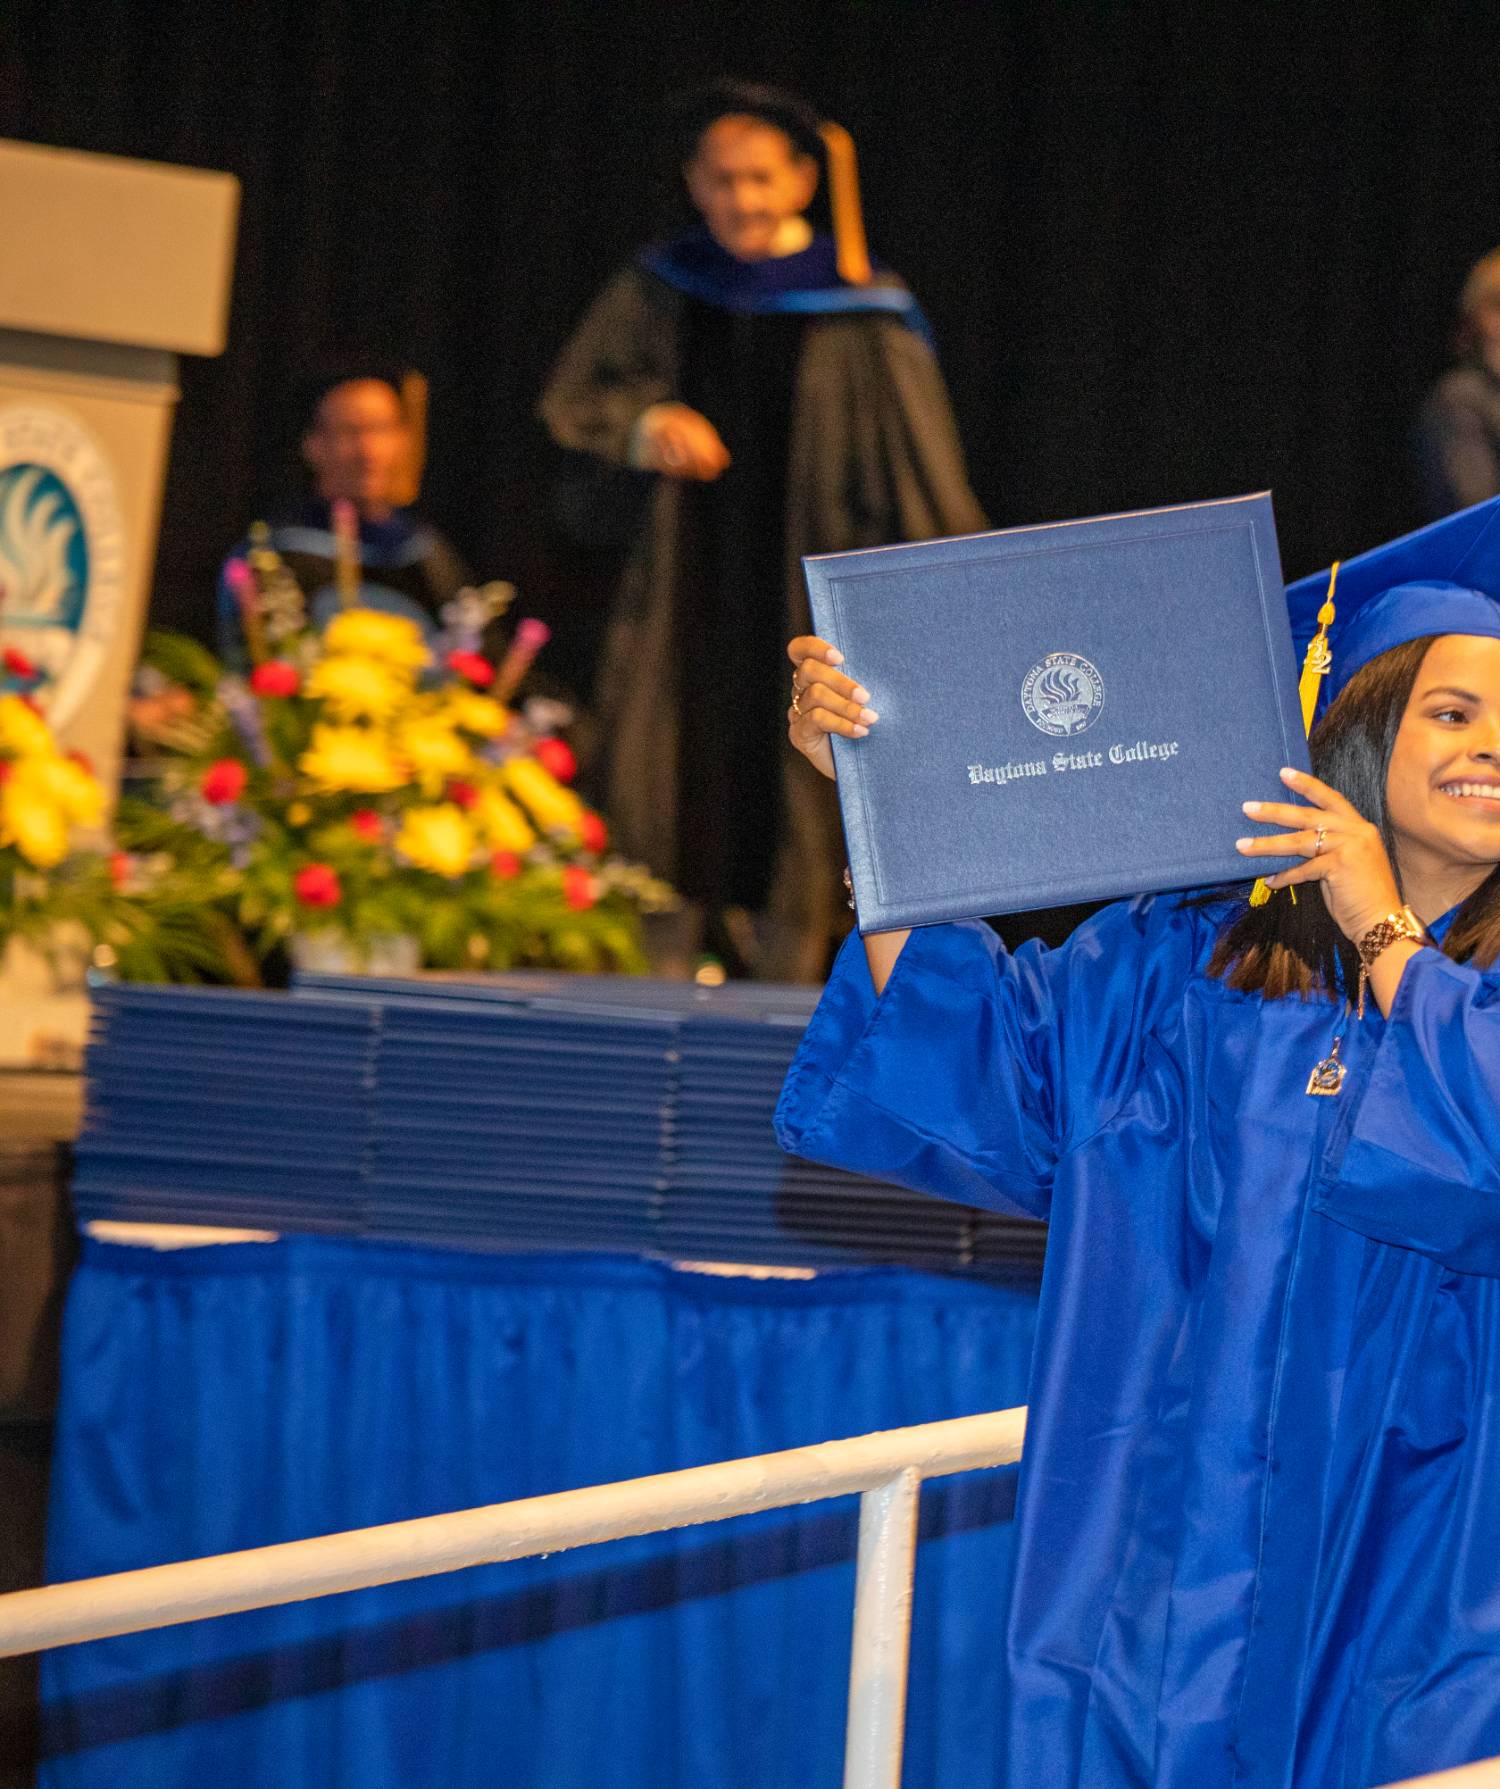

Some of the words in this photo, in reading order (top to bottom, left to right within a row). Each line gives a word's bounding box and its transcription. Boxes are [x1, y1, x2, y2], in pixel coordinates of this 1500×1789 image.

[1023, 665, 1044, 714] DAYTONA
[1044, 656, 1077, 668] STATE
[1079, 663, 1102, 707] COLLEGE
[967, 760, 1047, 785] Daytona
[1052, 752, 1103, 772] State
[1108, 740, 1179, 765] College
